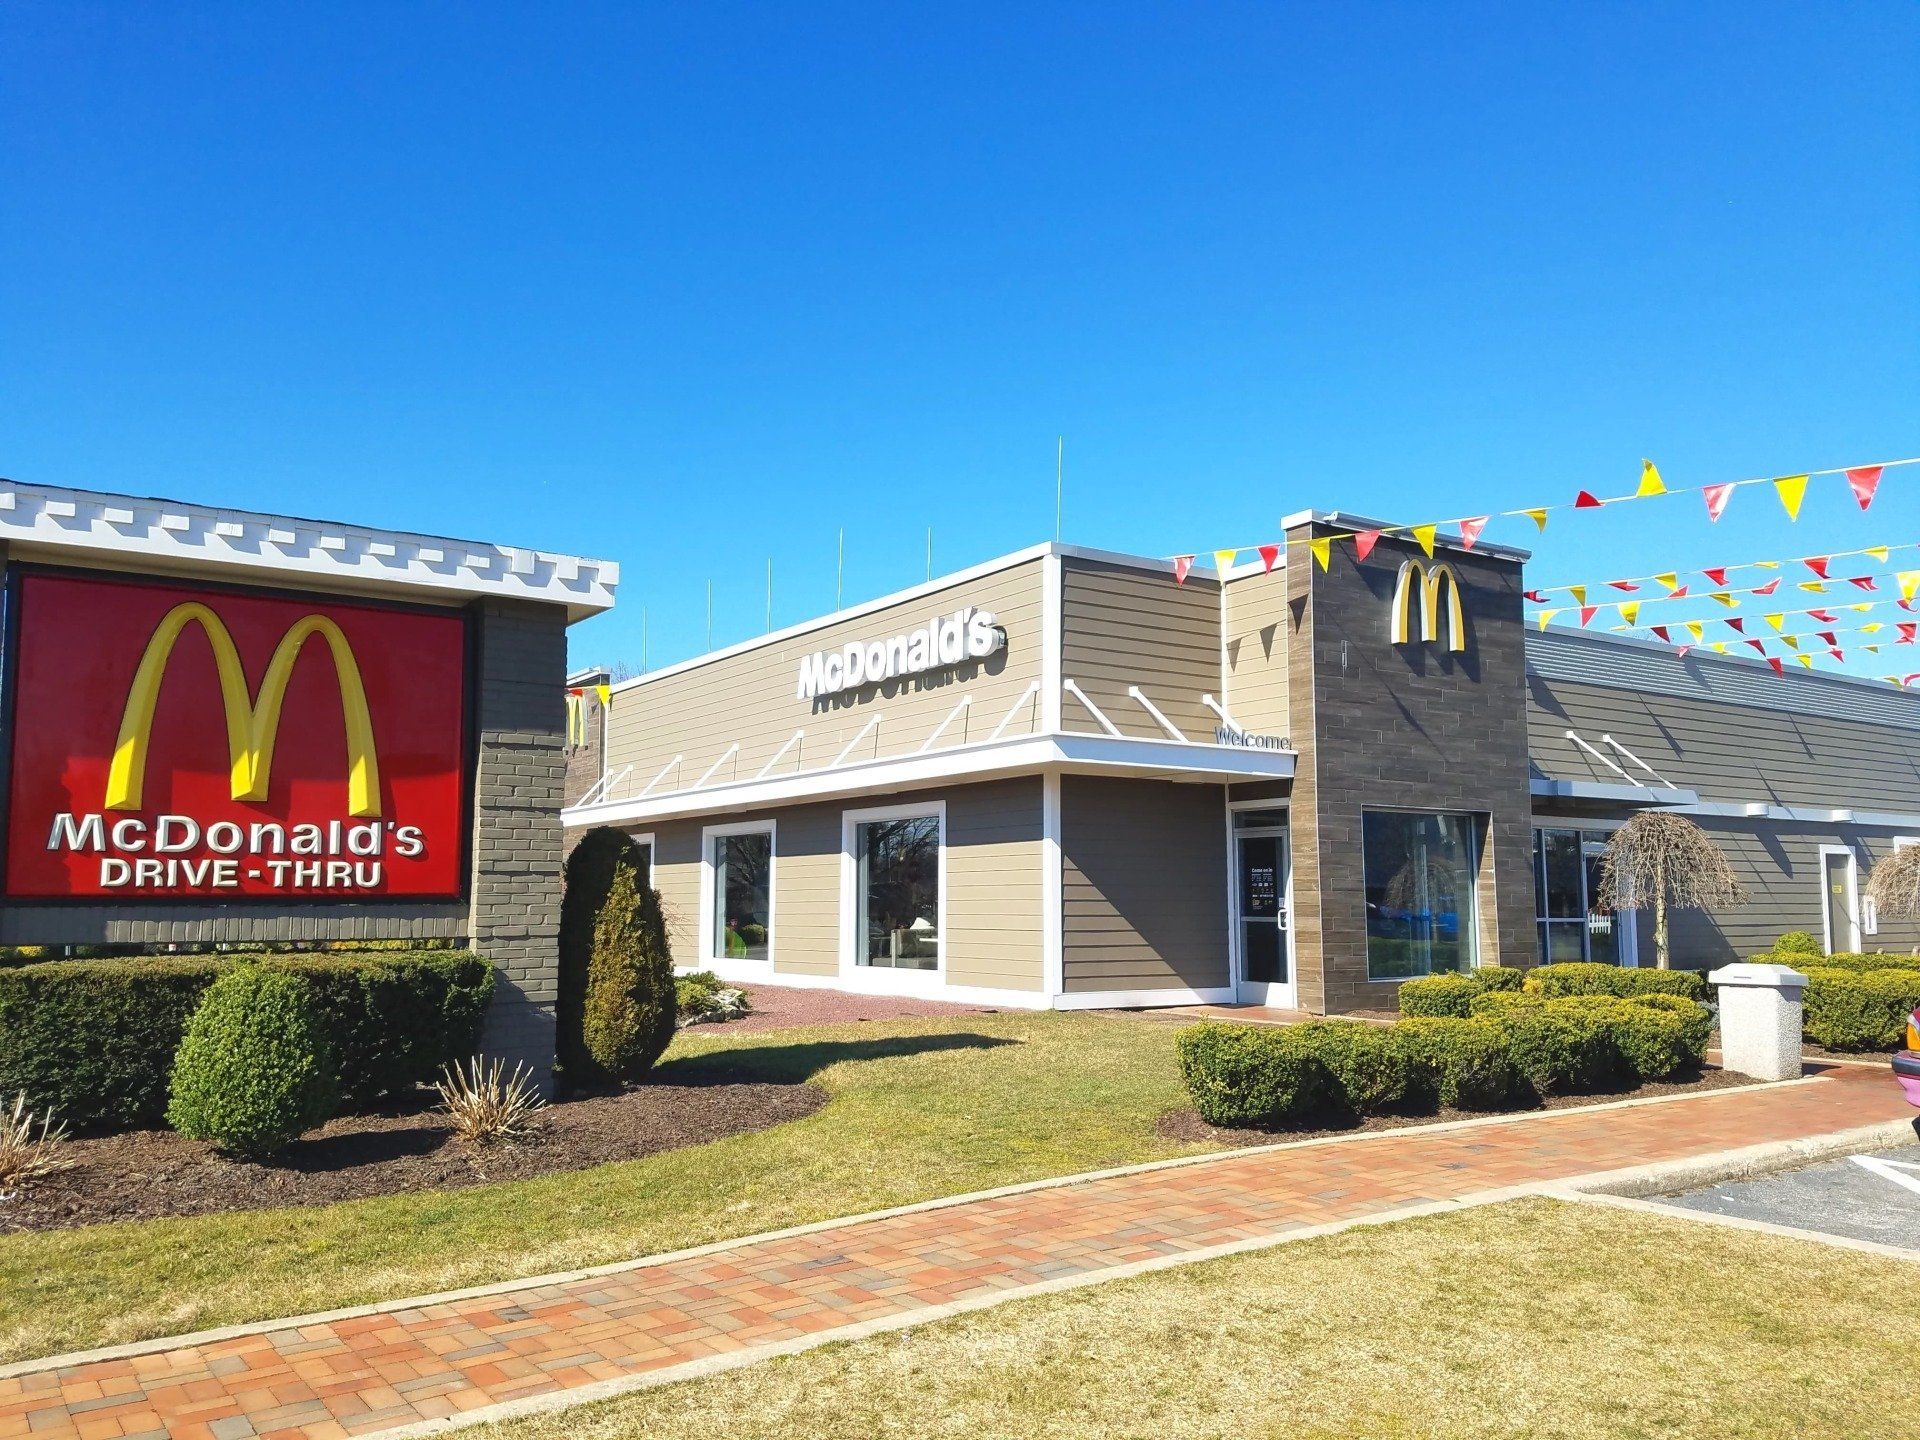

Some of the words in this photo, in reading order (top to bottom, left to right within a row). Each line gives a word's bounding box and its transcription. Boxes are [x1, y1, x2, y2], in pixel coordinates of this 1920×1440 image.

[796, 607, 1000, 700] McDonald's
[1214, 726, 1291, 750] Welcome
[45, 812, 425, 857] McDonald's
